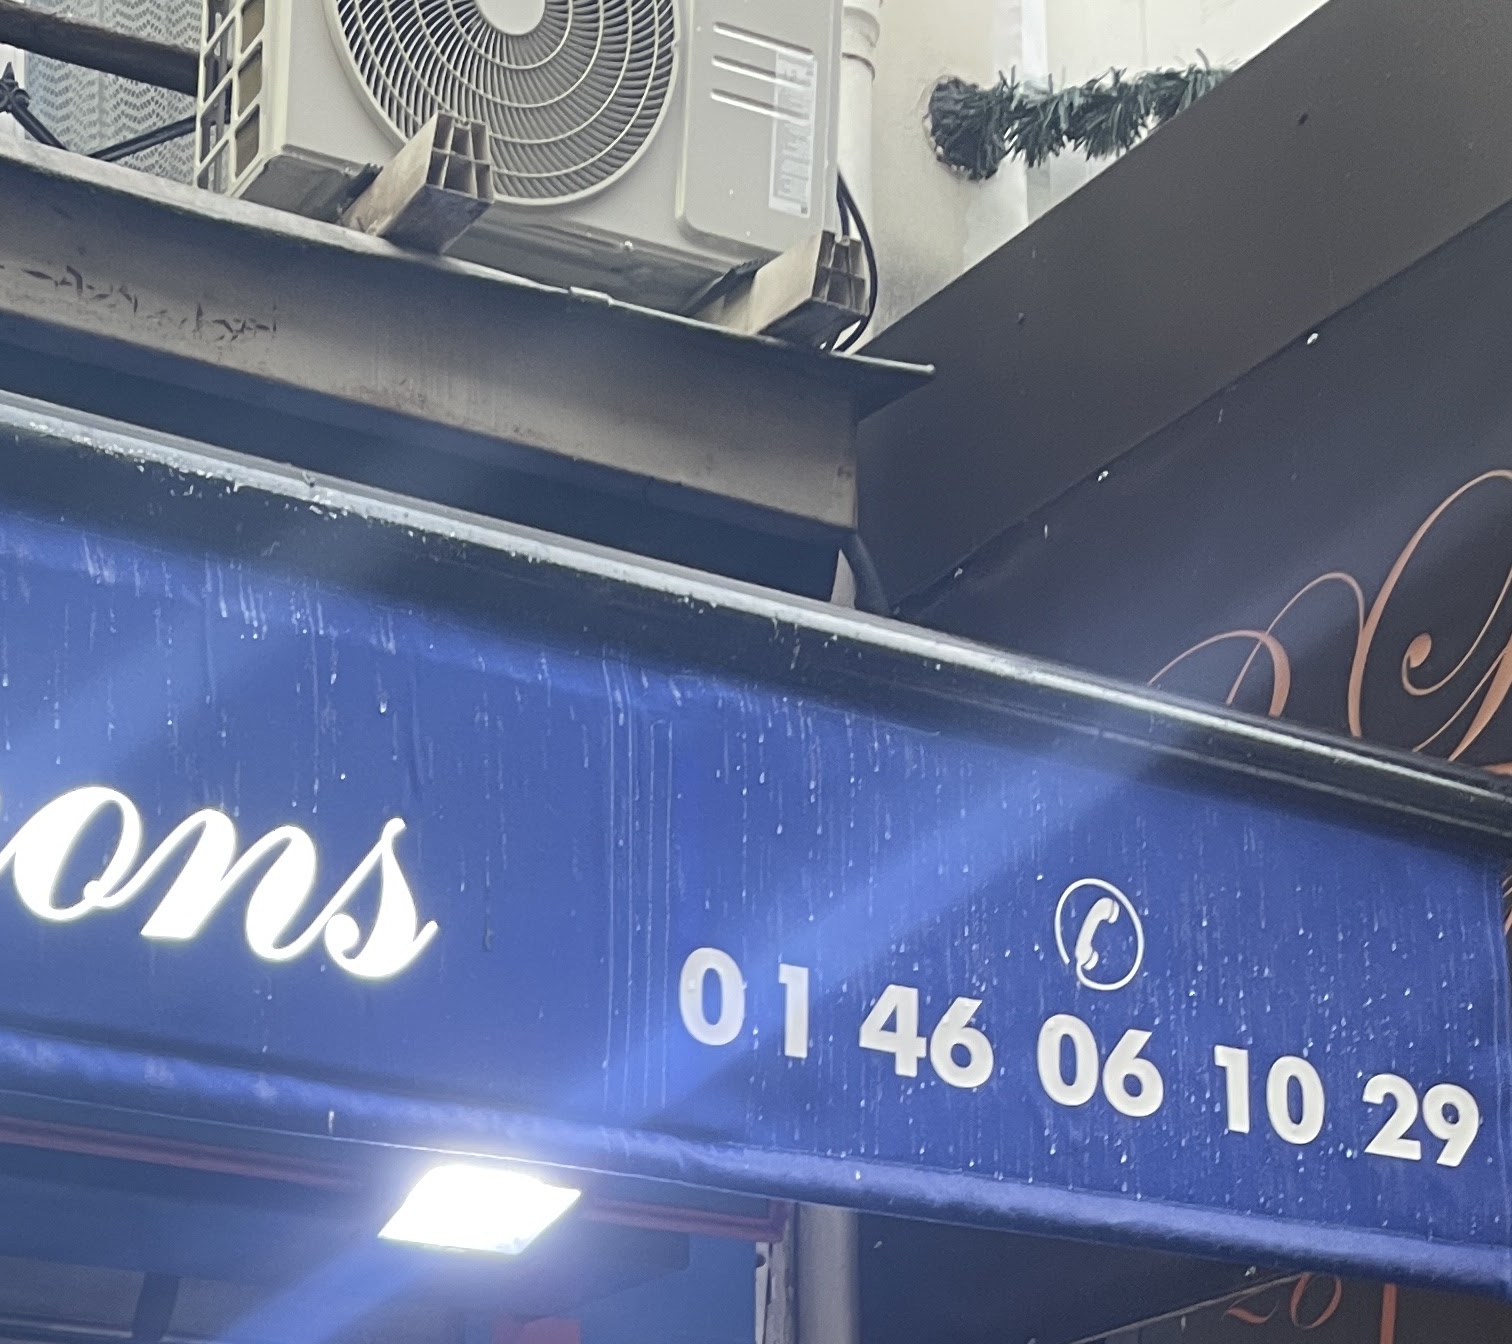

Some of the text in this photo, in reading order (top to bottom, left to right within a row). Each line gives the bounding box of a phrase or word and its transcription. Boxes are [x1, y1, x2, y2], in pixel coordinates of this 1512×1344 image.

[680, 947, 1480, 1168] 01 46 06 10 29
